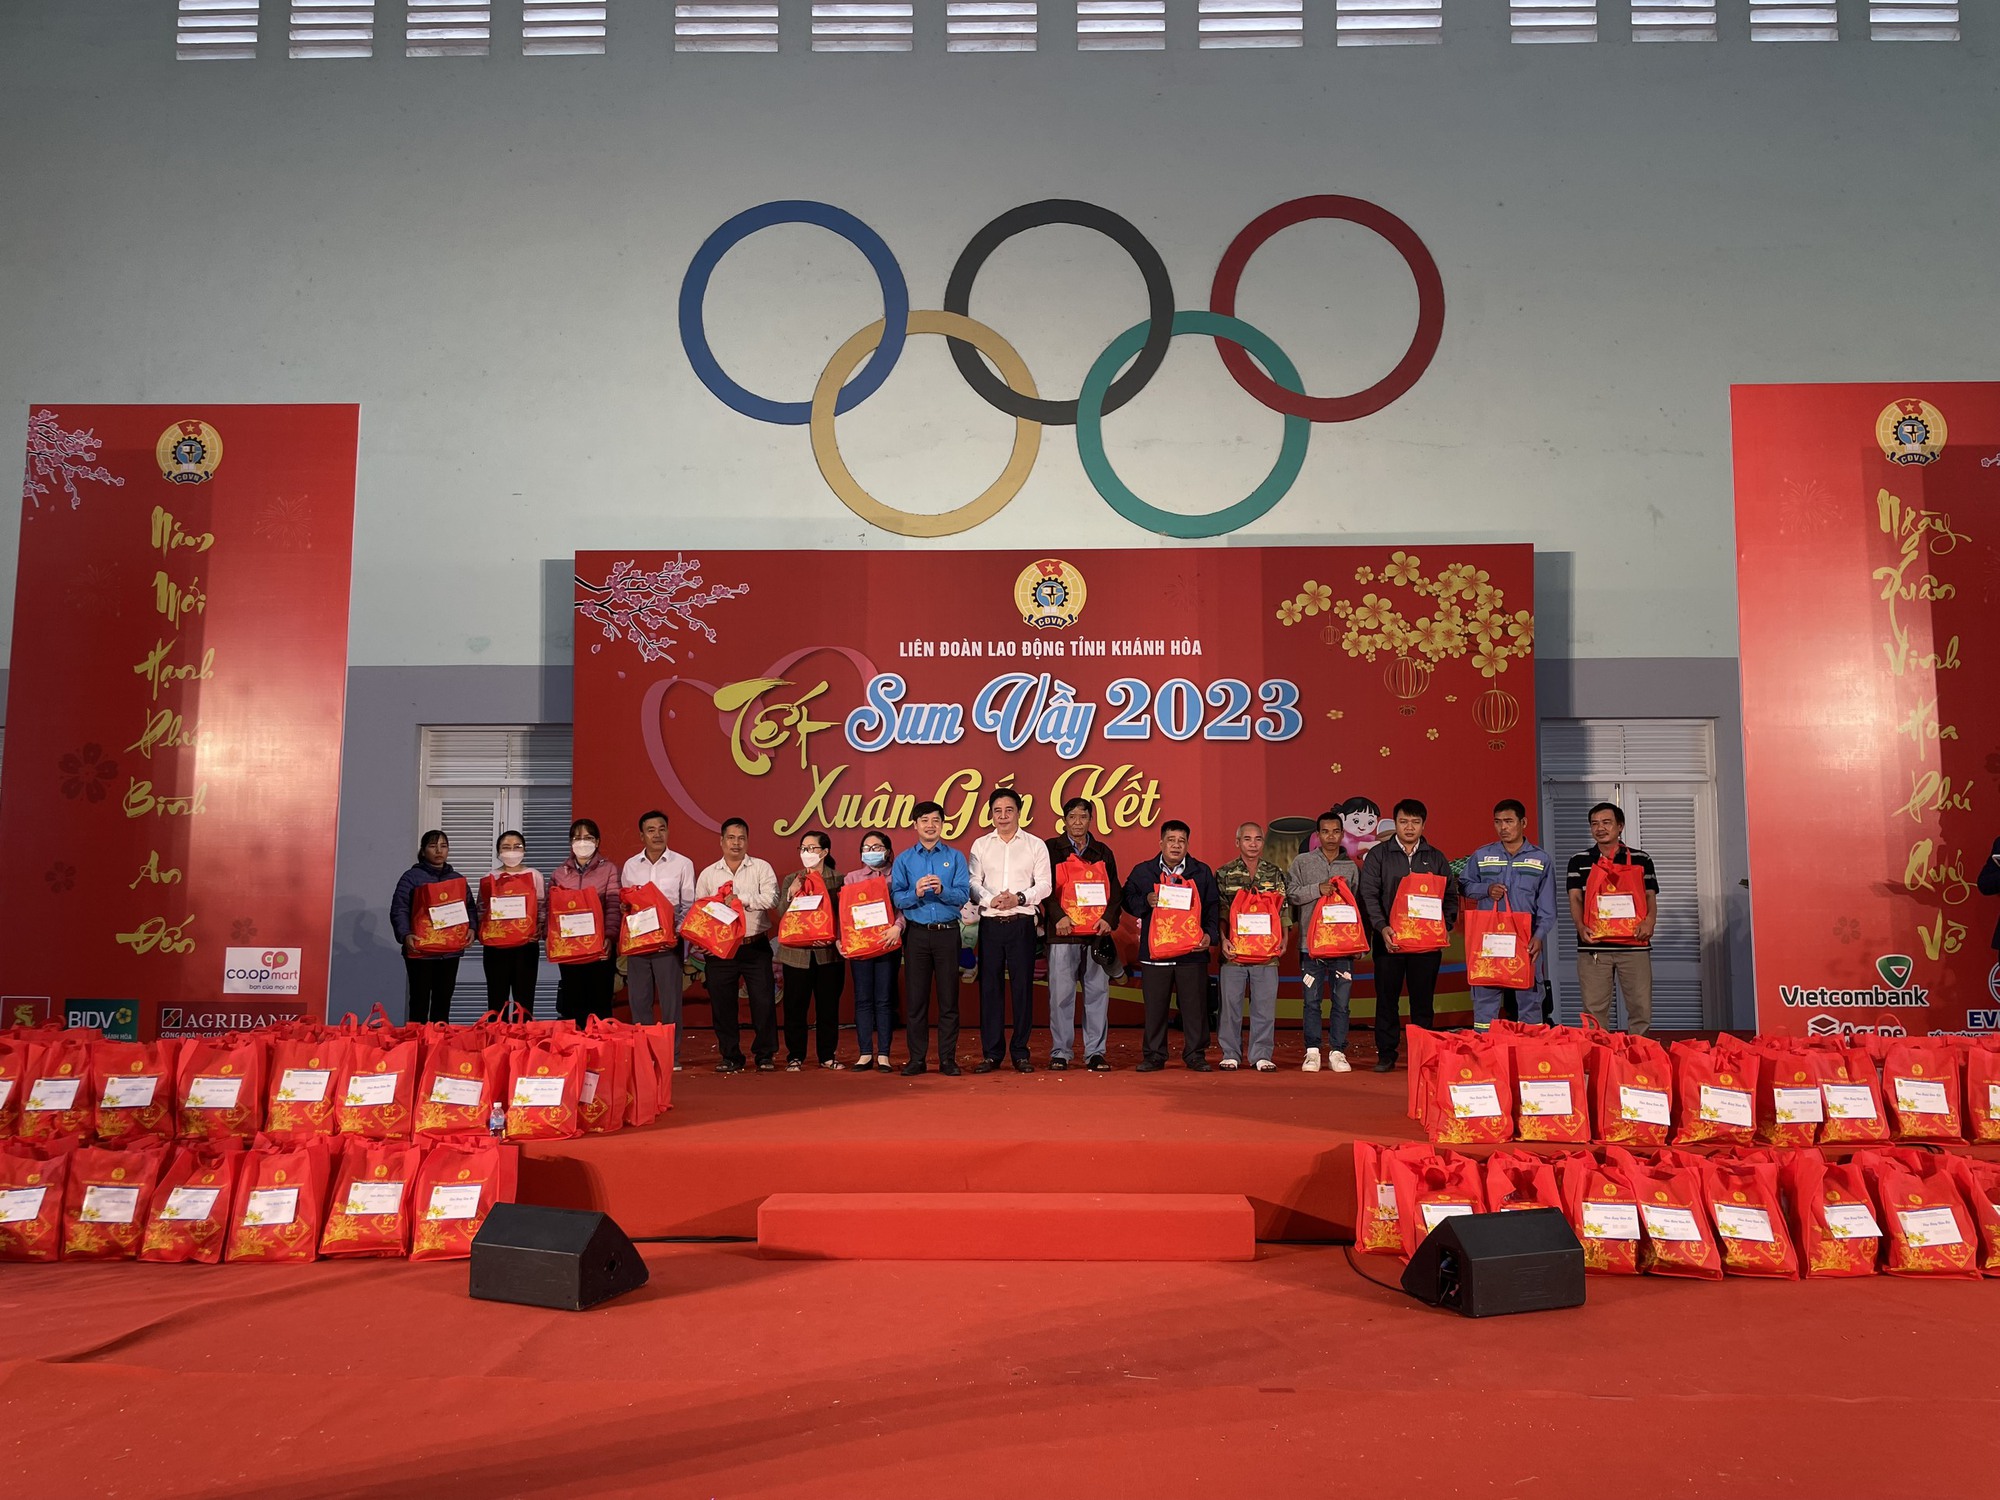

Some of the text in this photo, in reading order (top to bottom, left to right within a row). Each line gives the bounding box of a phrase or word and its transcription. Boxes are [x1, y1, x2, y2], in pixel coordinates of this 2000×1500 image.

[151, 570, 207, 630] Mới
[133, 637, 215, 701] Hạnh
[899, 635, 1203, 660] LIÊN ĐOÀN LAO ĐỘNG TỈNH KHÁNH HÒA
[1882, 624, 1961, 676] Vinh
[713, 672, 1303, 776] Tết Sum Vầy 2023
[122, 777, 208, 819] Bình
[773, 764, 917, 837] Xuân
[1050, 764, 1161, 836] Kết
[1891, 770, 1974, 823] Phú
[129, 850, 182, 889] An
[1904, 838, 1979, 905] Quý
[116, 914, 196, 954] Đến
[1917, 908, 1969, 960] Về
[68, 1010, 116, 1029] BIDV
[1780, 985, 1929, 1007] Vietcombank
[1967, 1010, 2000, 1028] EV
